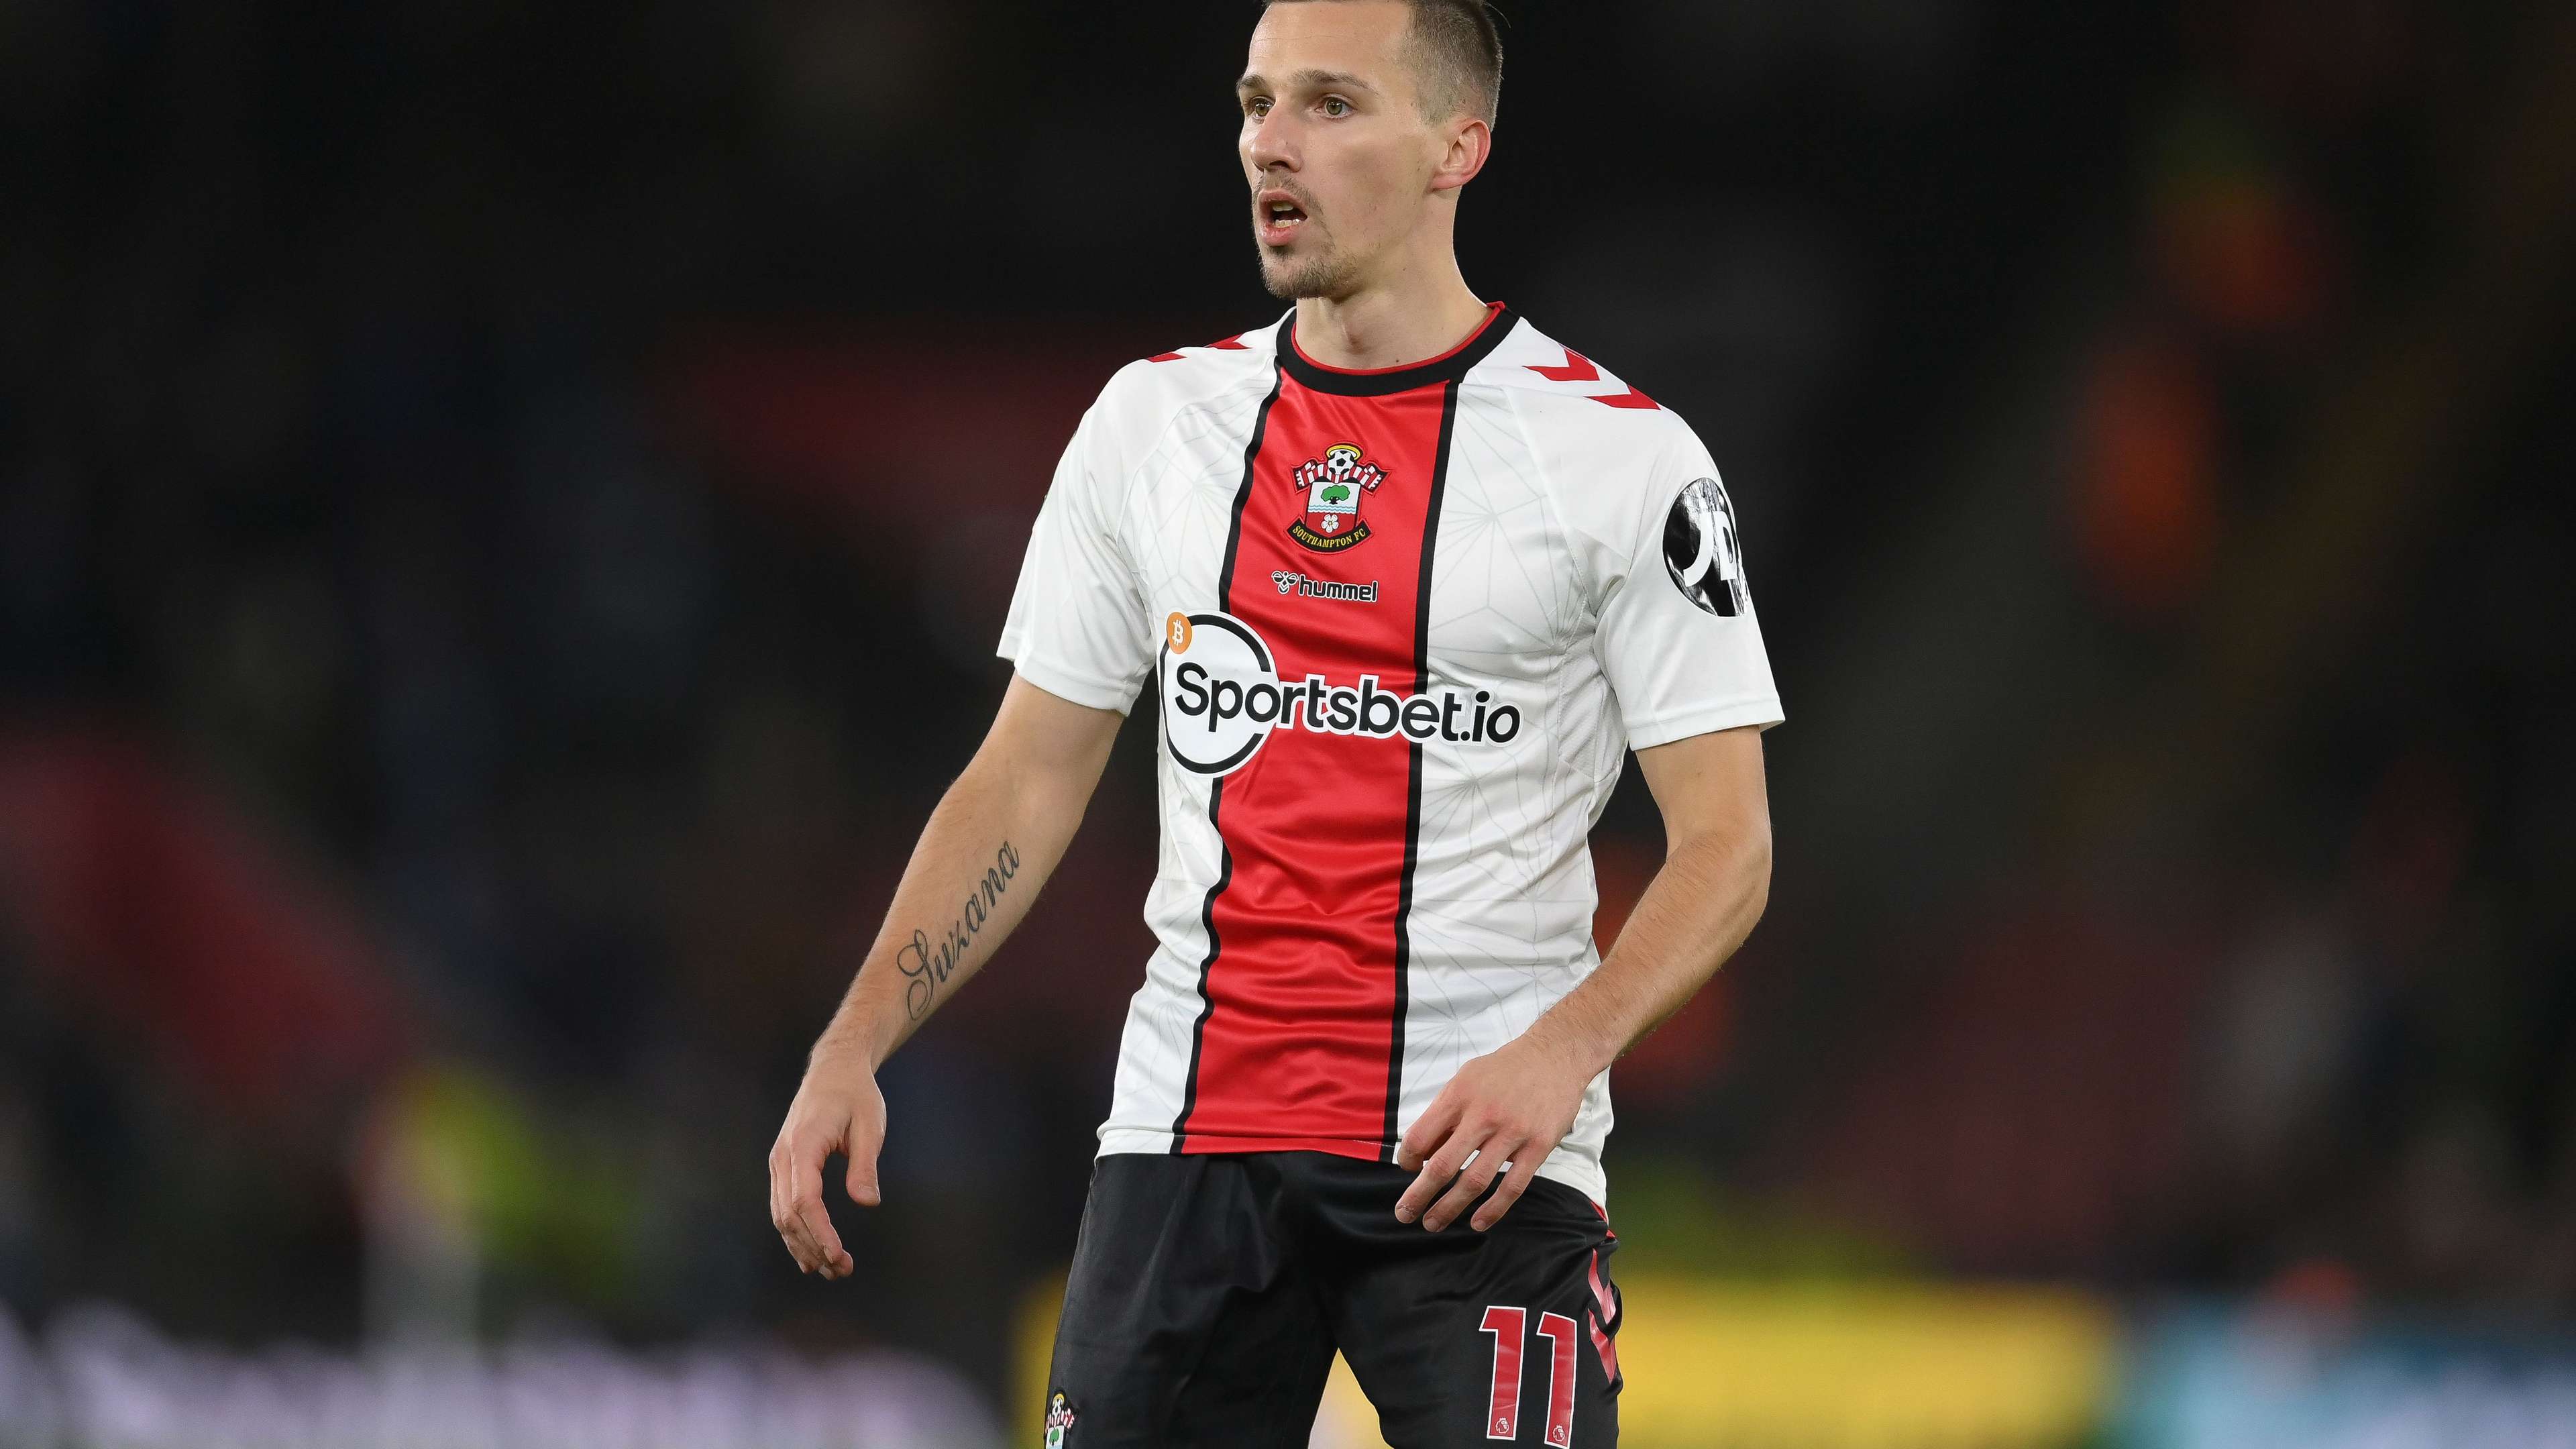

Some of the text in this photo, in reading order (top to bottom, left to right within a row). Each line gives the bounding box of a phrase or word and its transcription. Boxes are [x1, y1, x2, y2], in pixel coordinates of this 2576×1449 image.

[1293, 525, 1366, 547] SOUTHAMPTON FC
[1299, 575, 1378, 601] hummel
[1174, 661, 1521, 744] Sportsbet.io
[1479, 1305, 1577, 1449] 11
